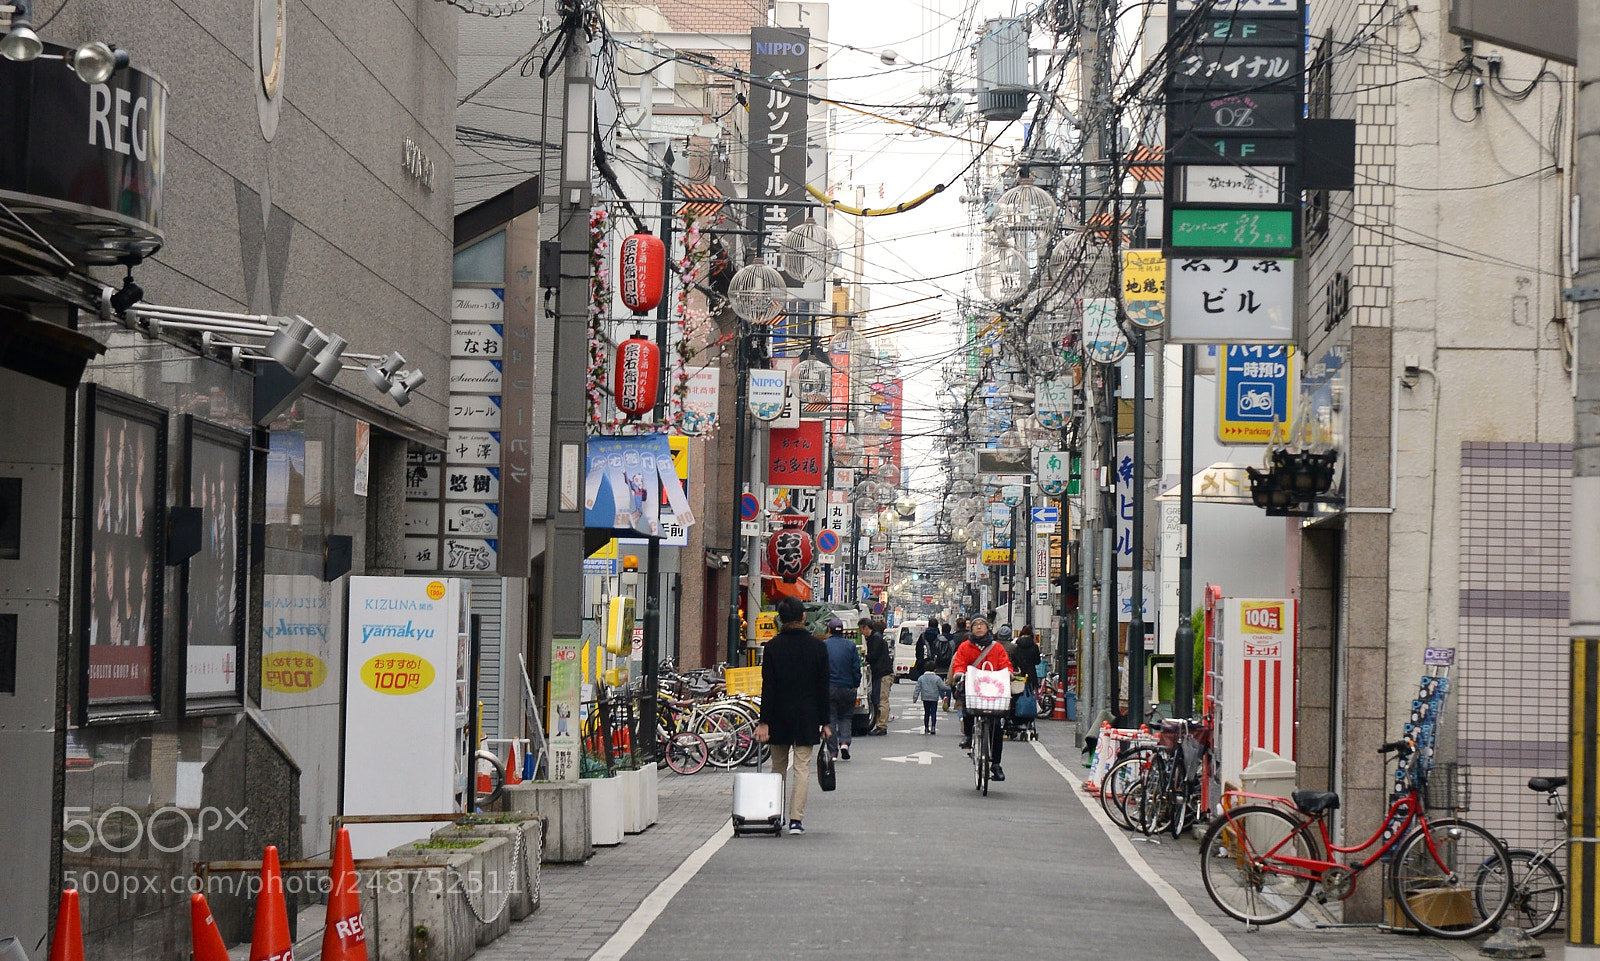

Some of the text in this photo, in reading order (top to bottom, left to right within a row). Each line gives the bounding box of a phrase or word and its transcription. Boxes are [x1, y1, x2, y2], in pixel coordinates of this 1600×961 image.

[755, 42, 805, 56] NIPPO
[1182, 55, 1289, 78] ファイナル
[89, 82, 148, 162] REG
[1215, 107, 1254, 126] OZ
[624, 238, 639, 307] 宗右衛門町
[1202, 288, 1261, 314] ビル
[464, 338, 498, 354] なお
[623, 344, 639, 411] 宗右衛門町
[1229, 362, 1286, 378] 一時預り
[752, 378, 783, 387] NIPPO
[1041, 391, 1067, 401] ハウス
[453, 406, 496, 417] フルール
[1244, 428, 1270, 436] Parking
[455, 443, 492, 460] 中澤
[449, 474, 492, 493] 悠樹
[832, 506, 842, 529] 丸岩
[448, 550, 490, 570] YES
[776, 532, 802, 574] おでん
[365, 599, 417, 610] KIZUNA
[361, 620, 435, 643] yamakyu
[1246, 644, 1279, 655] チェリオ
[1425, 650, 1453, 659] DEEP
[374, 659, 421, 669] おすすめ!
[374, 672, 420, 689] 100円
